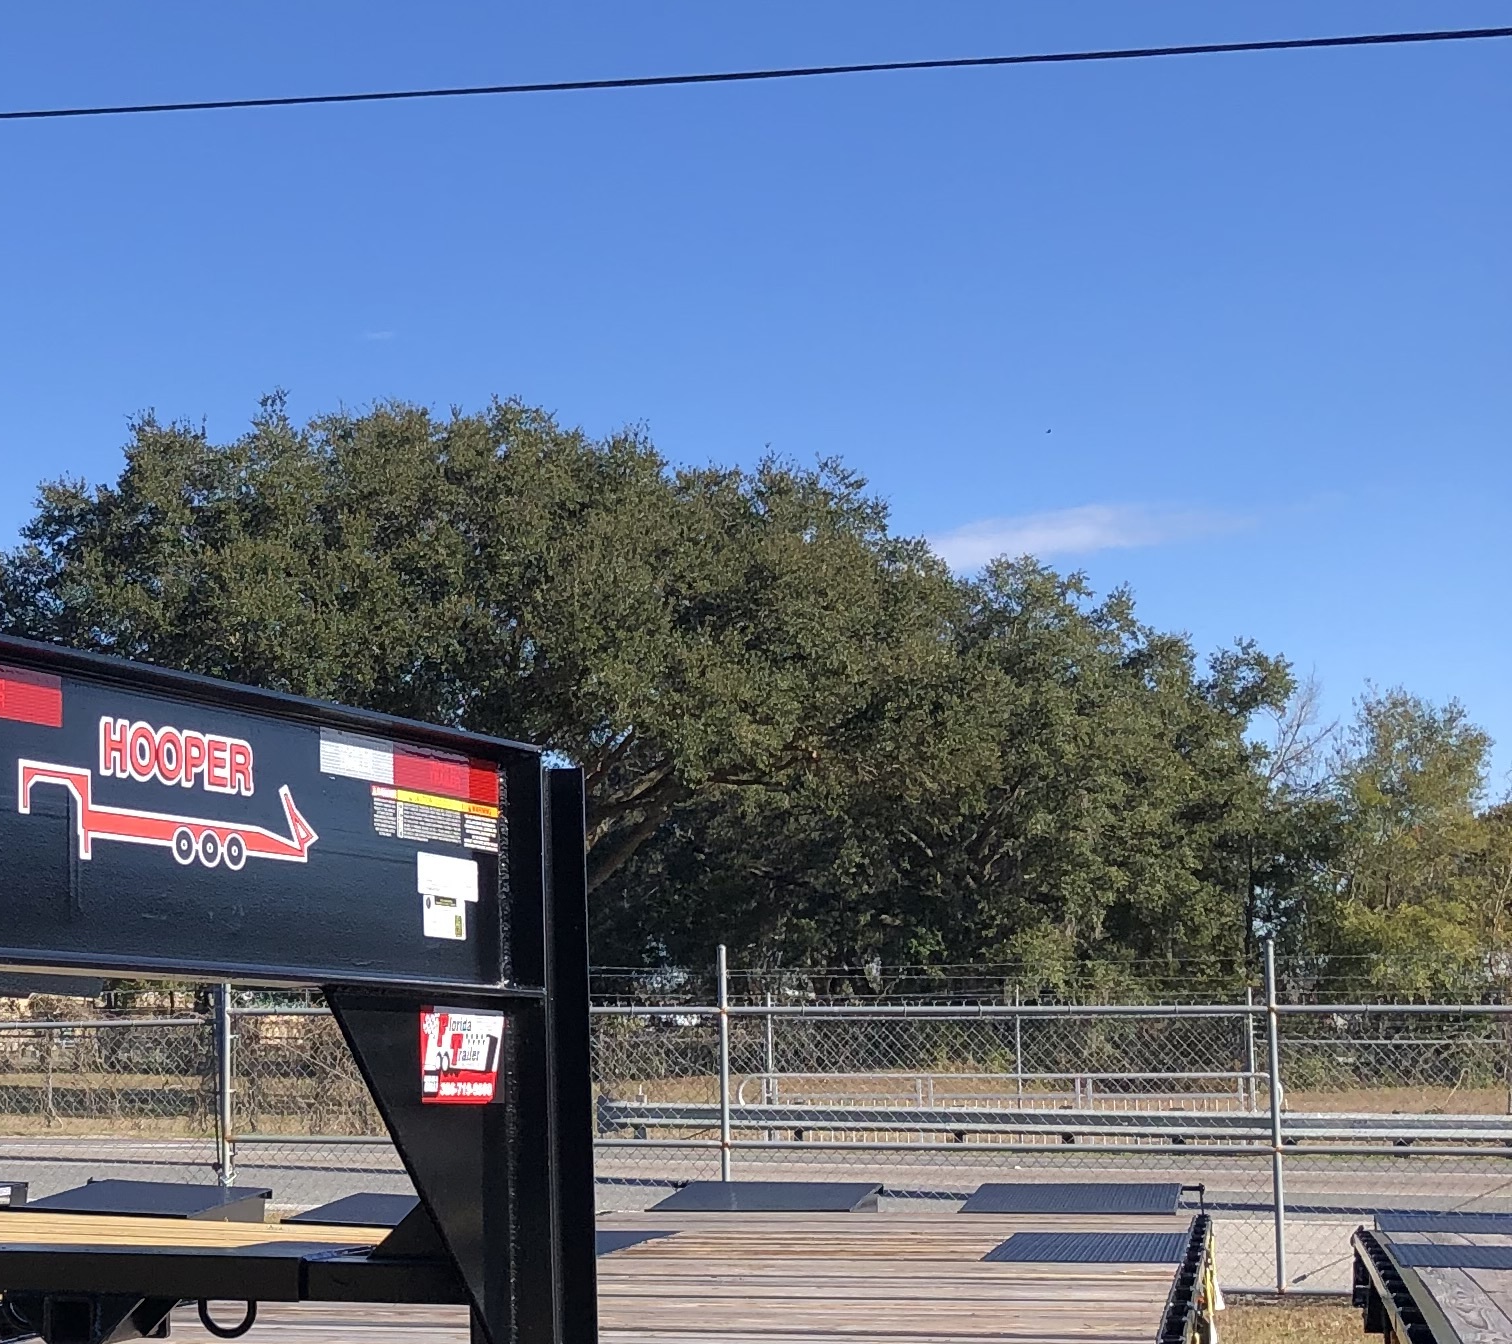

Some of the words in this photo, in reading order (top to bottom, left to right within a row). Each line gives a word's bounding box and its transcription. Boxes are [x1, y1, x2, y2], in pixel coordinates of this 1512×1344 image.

[100, 717, 254, 796] HOOPER
[437, 1013, 472, 1047] Florida
[450, 1033, 480, 1066] Trailer
